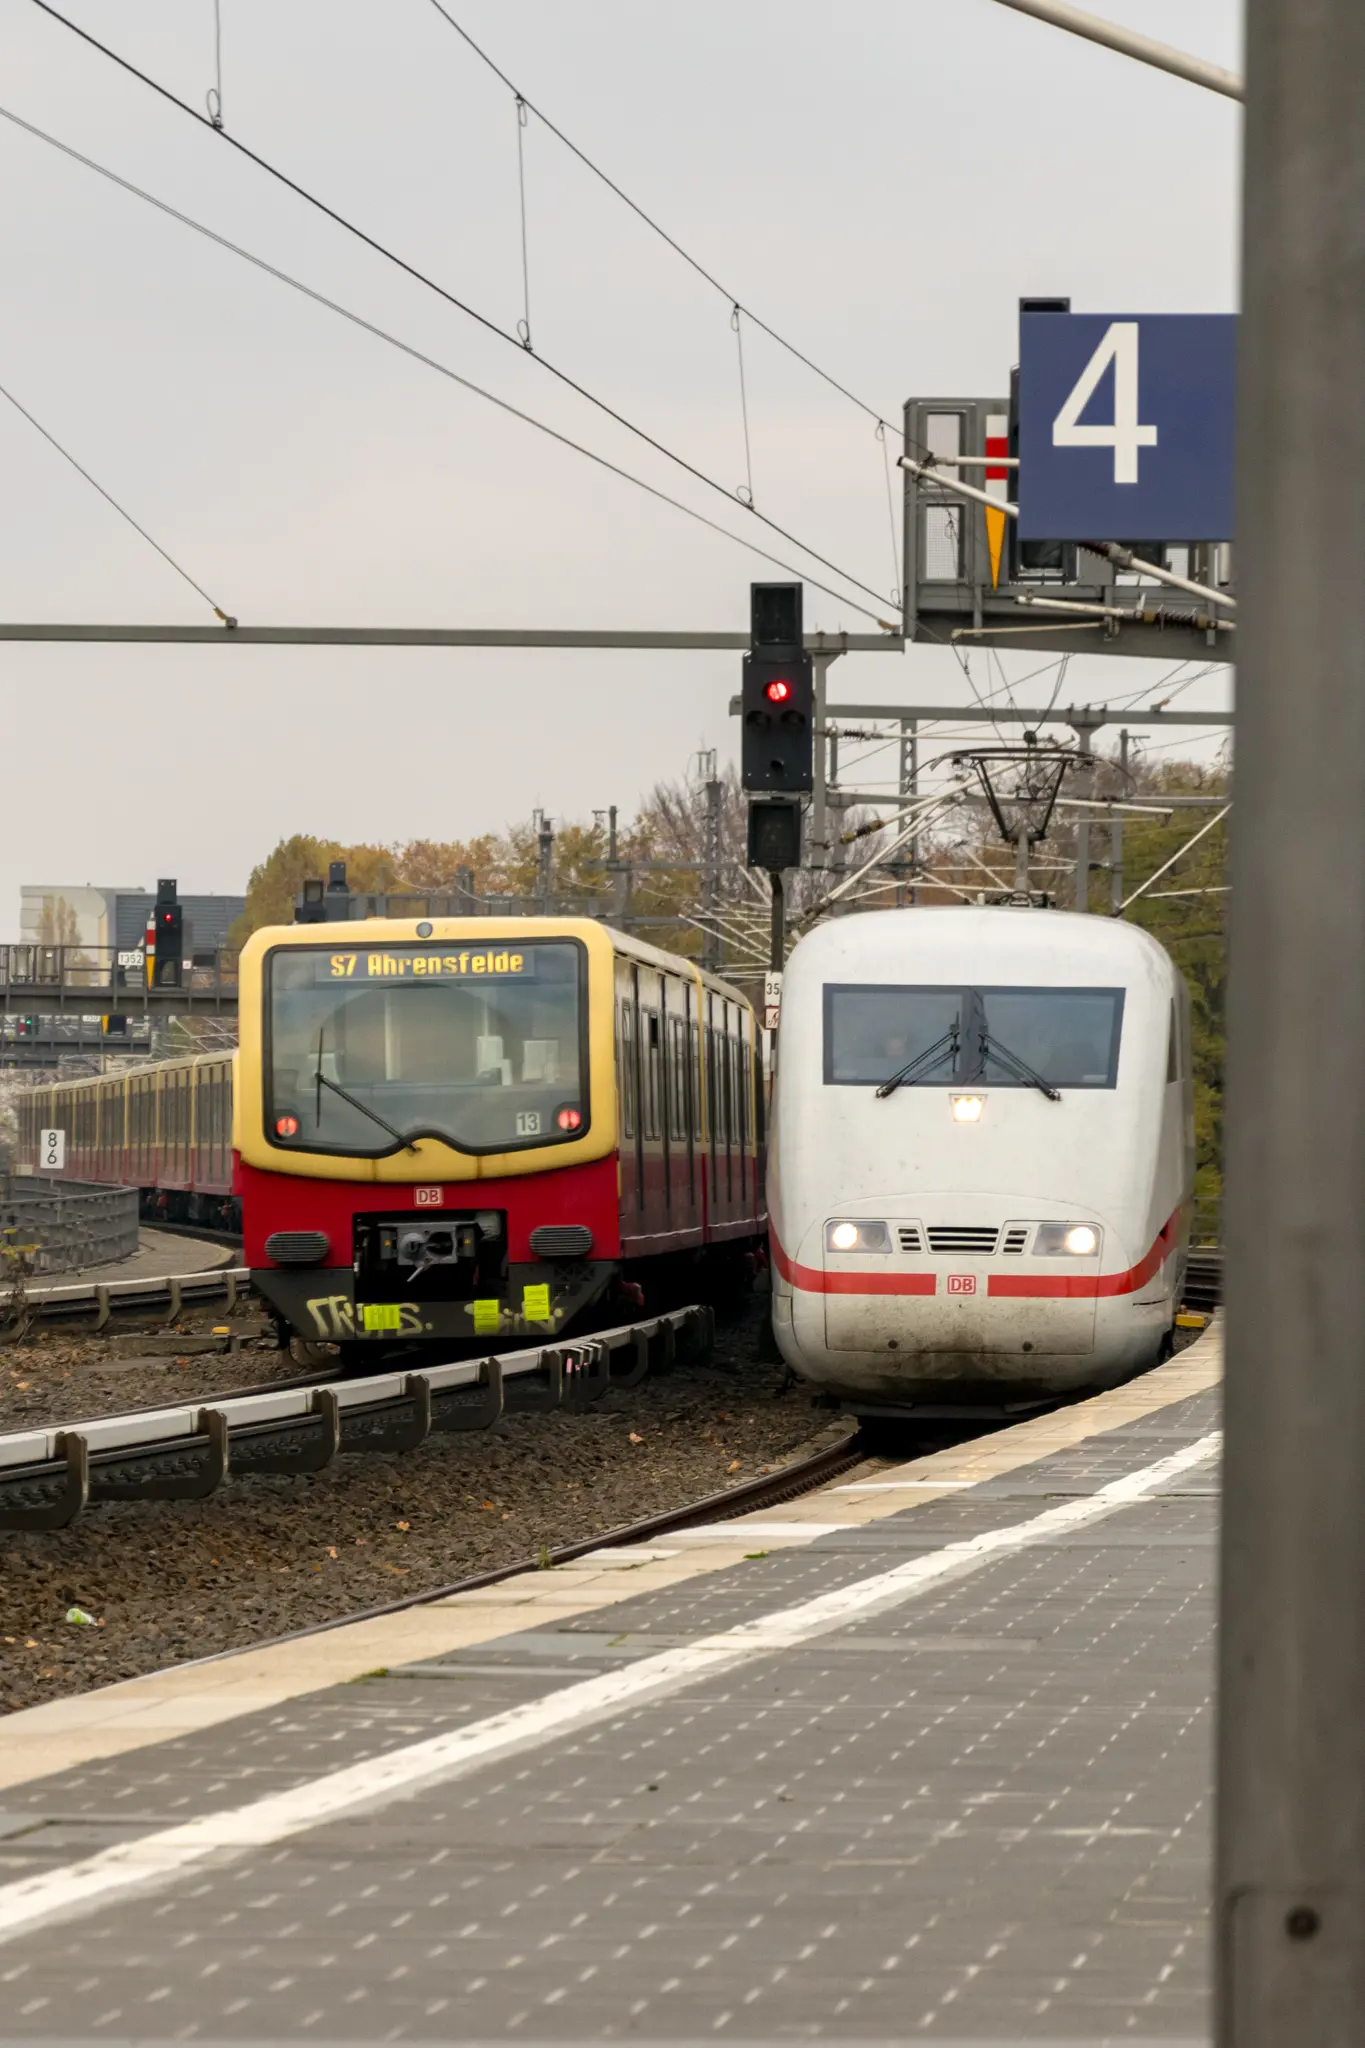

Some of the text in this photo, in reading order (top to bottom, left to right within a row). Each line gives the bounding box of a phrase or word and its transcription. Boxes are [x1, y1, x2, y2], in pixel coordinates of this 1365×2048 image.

[1052, 321, 1158, 484] 4
[119, 954, 143, 965] 1352
[330, 951, 524, 977] S7 Ahrensfelde
[518, 1114, 538, 1131] 13
[48, 1132, 57, 1148] 8
[47, 1149, 57, 1164] 6
[419, 1189, 439, 1203] DB
[951, 1278, 973, 1291] DB
